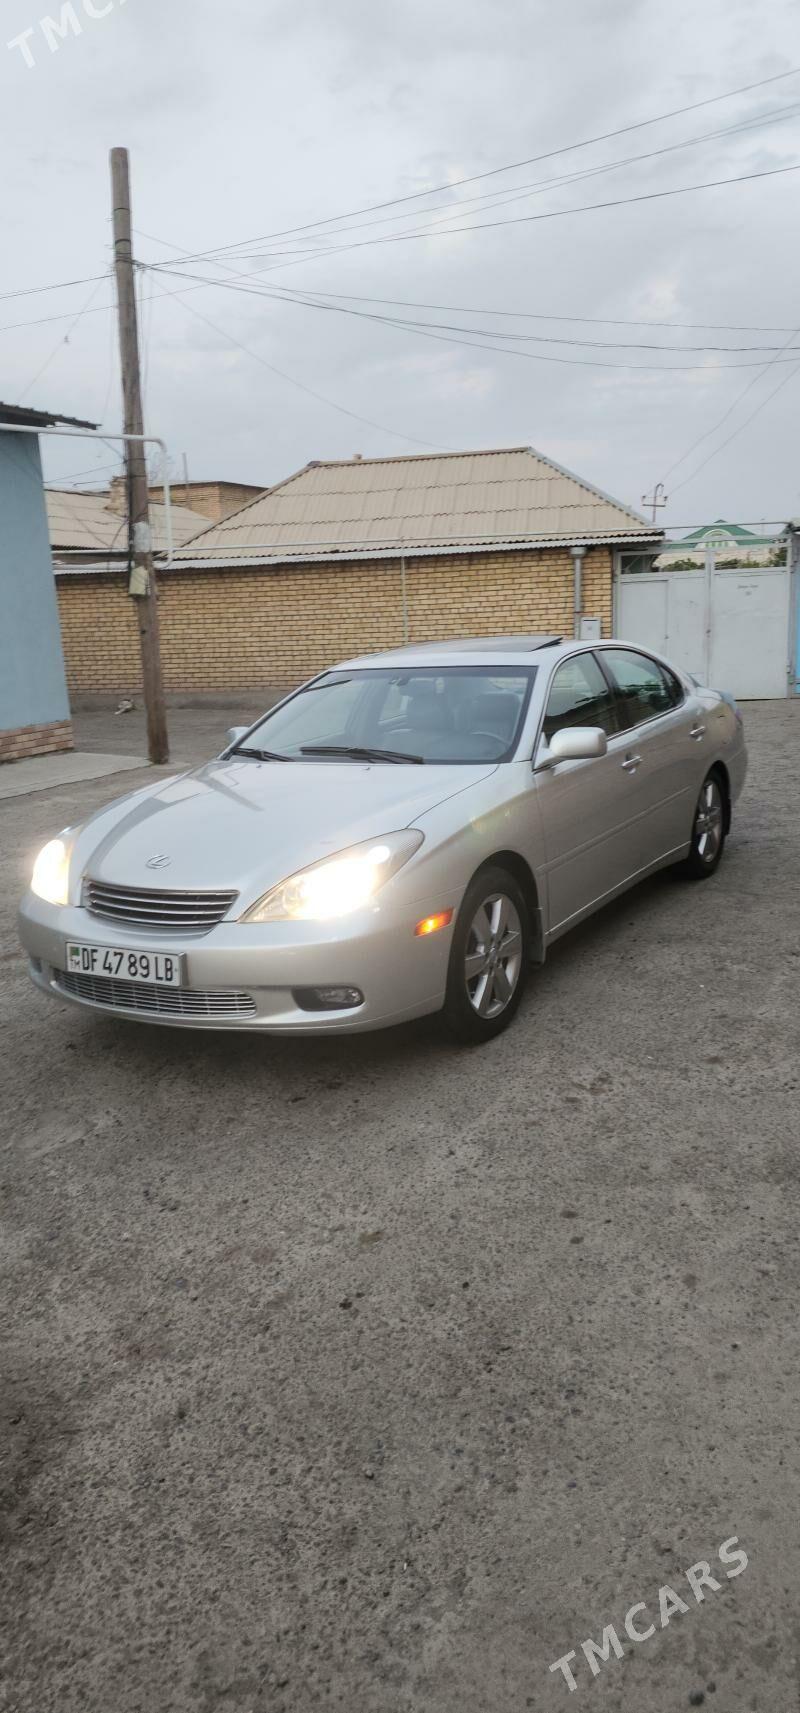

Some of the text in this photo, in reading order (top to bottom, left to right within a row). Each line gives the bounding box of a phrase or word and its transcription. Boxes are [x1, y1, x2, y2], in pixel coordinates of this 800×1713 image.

[82, 947, 173, 981] DF 47 89 LB
